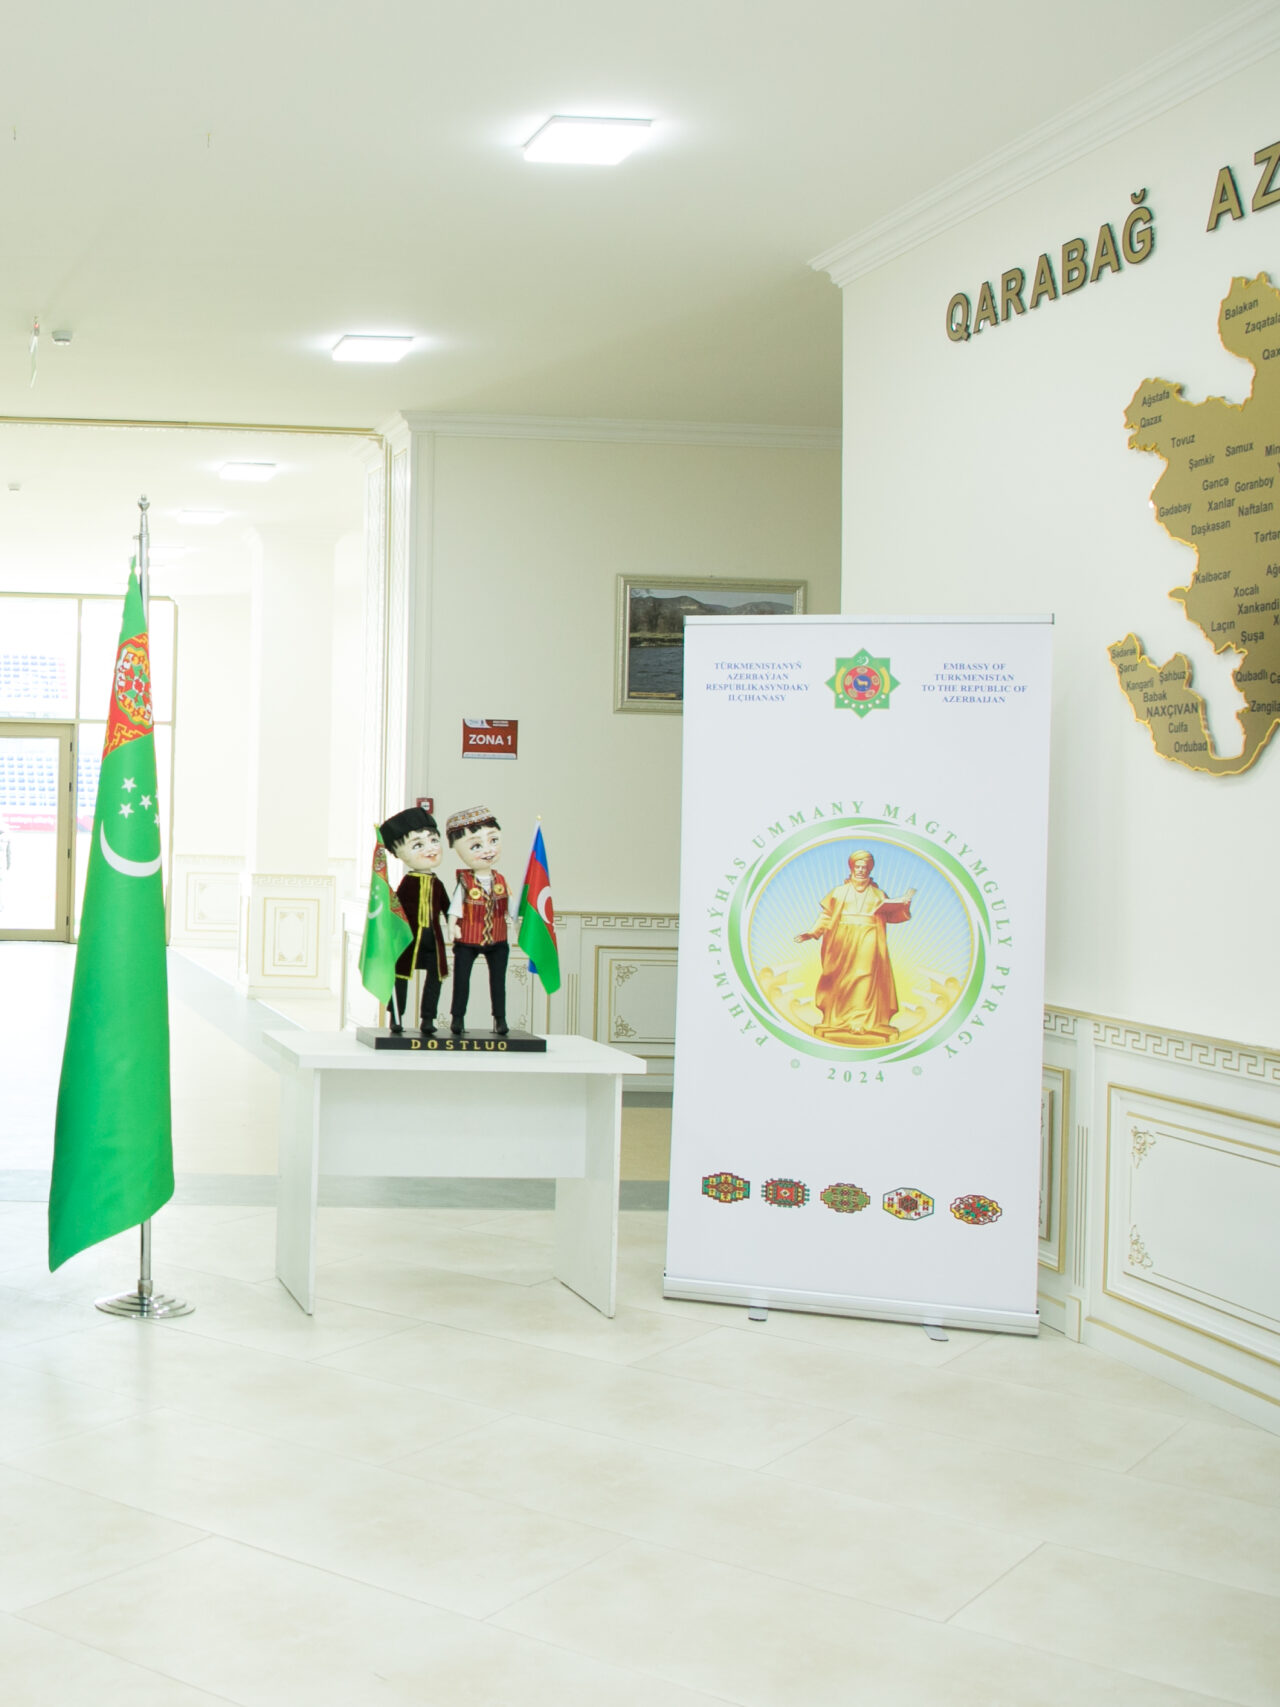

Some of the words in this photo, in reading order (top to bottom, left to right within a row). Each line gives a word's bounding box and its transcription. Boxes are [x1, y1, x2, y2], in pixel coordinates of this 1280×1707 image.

[945, 188, 1156, 343] QARABAĞ
[1140, 414, 1162, 428] Qazax
[1171, 434, 1195, 448] Tovuz
[1225, 442, 1254, 457] Samux
[1234, 476, 1274, 493] Goranboy
[1208, 497, 1236, 512] Xanlar
[1238, 502, 1274, 517] Naftalan
[1241, 630, 1265, 644] Şuşa
[943, 663, 990, 671] EMBASSY
[992, 663, 1007, 671] OF
[706, 683, 810, 692] RESPUBLIKASYNDAKY
[921, 684, 936, 692] TO
[938, 684, 958, 692] THE
[960, 685, 1011, 693] REPUBLIC
[1013, 685, 1028, 693] OF
[942, 696, 1006, 704] AZERBAIJAN
[1146, 702, 1199, 718] NAXÇIVAN
[1168, 722, 1188, 733] Culfa
[468, 735, 504, 745] ZONA
[507, 735, 512, 746] 1
[1174, 741, 1207, 753] Ordubad
[751, 800, 865, 849] UMMANY
[882, 803, 1013, 949] MAGTYMGULY
[942, 965, 1010, 1059] PYRAGY
[411, 1039, 508, 1050] DOSTLUQ
[827, 1067, 885, 1084] 2024
